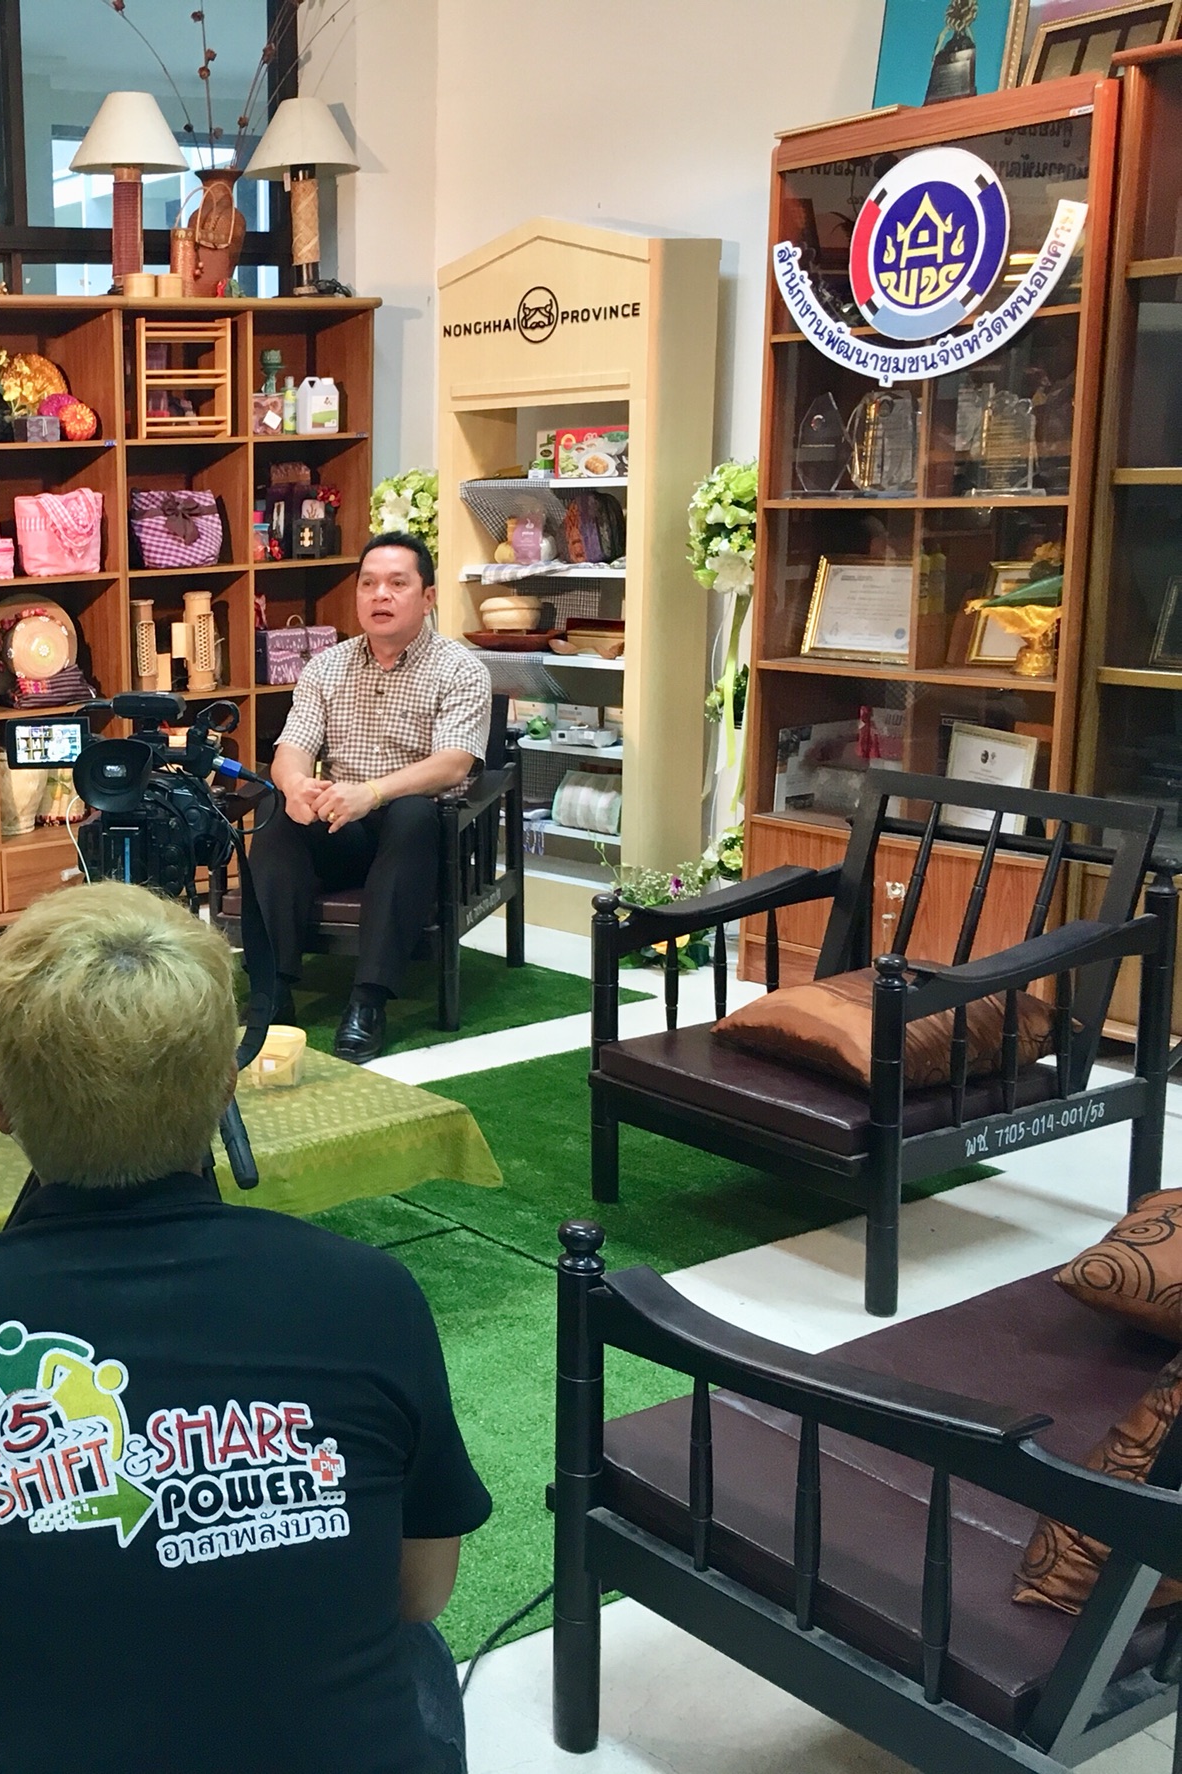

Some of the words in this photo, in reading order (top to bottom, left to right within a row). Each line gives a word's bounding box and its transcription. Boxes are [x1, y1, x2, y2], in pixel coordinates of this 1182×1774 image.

[560, 302, 641, 324] PROVINCE
[995, 1099, 1106, 1147] 7105-014-001/58
[2, 1402, 53, 1453] 5
[124, 1438, 160, 1477] &
[146, 1405, 312, 1472] SHARE
[161, 1513, 347, 1563] อาสาพลังบวก
